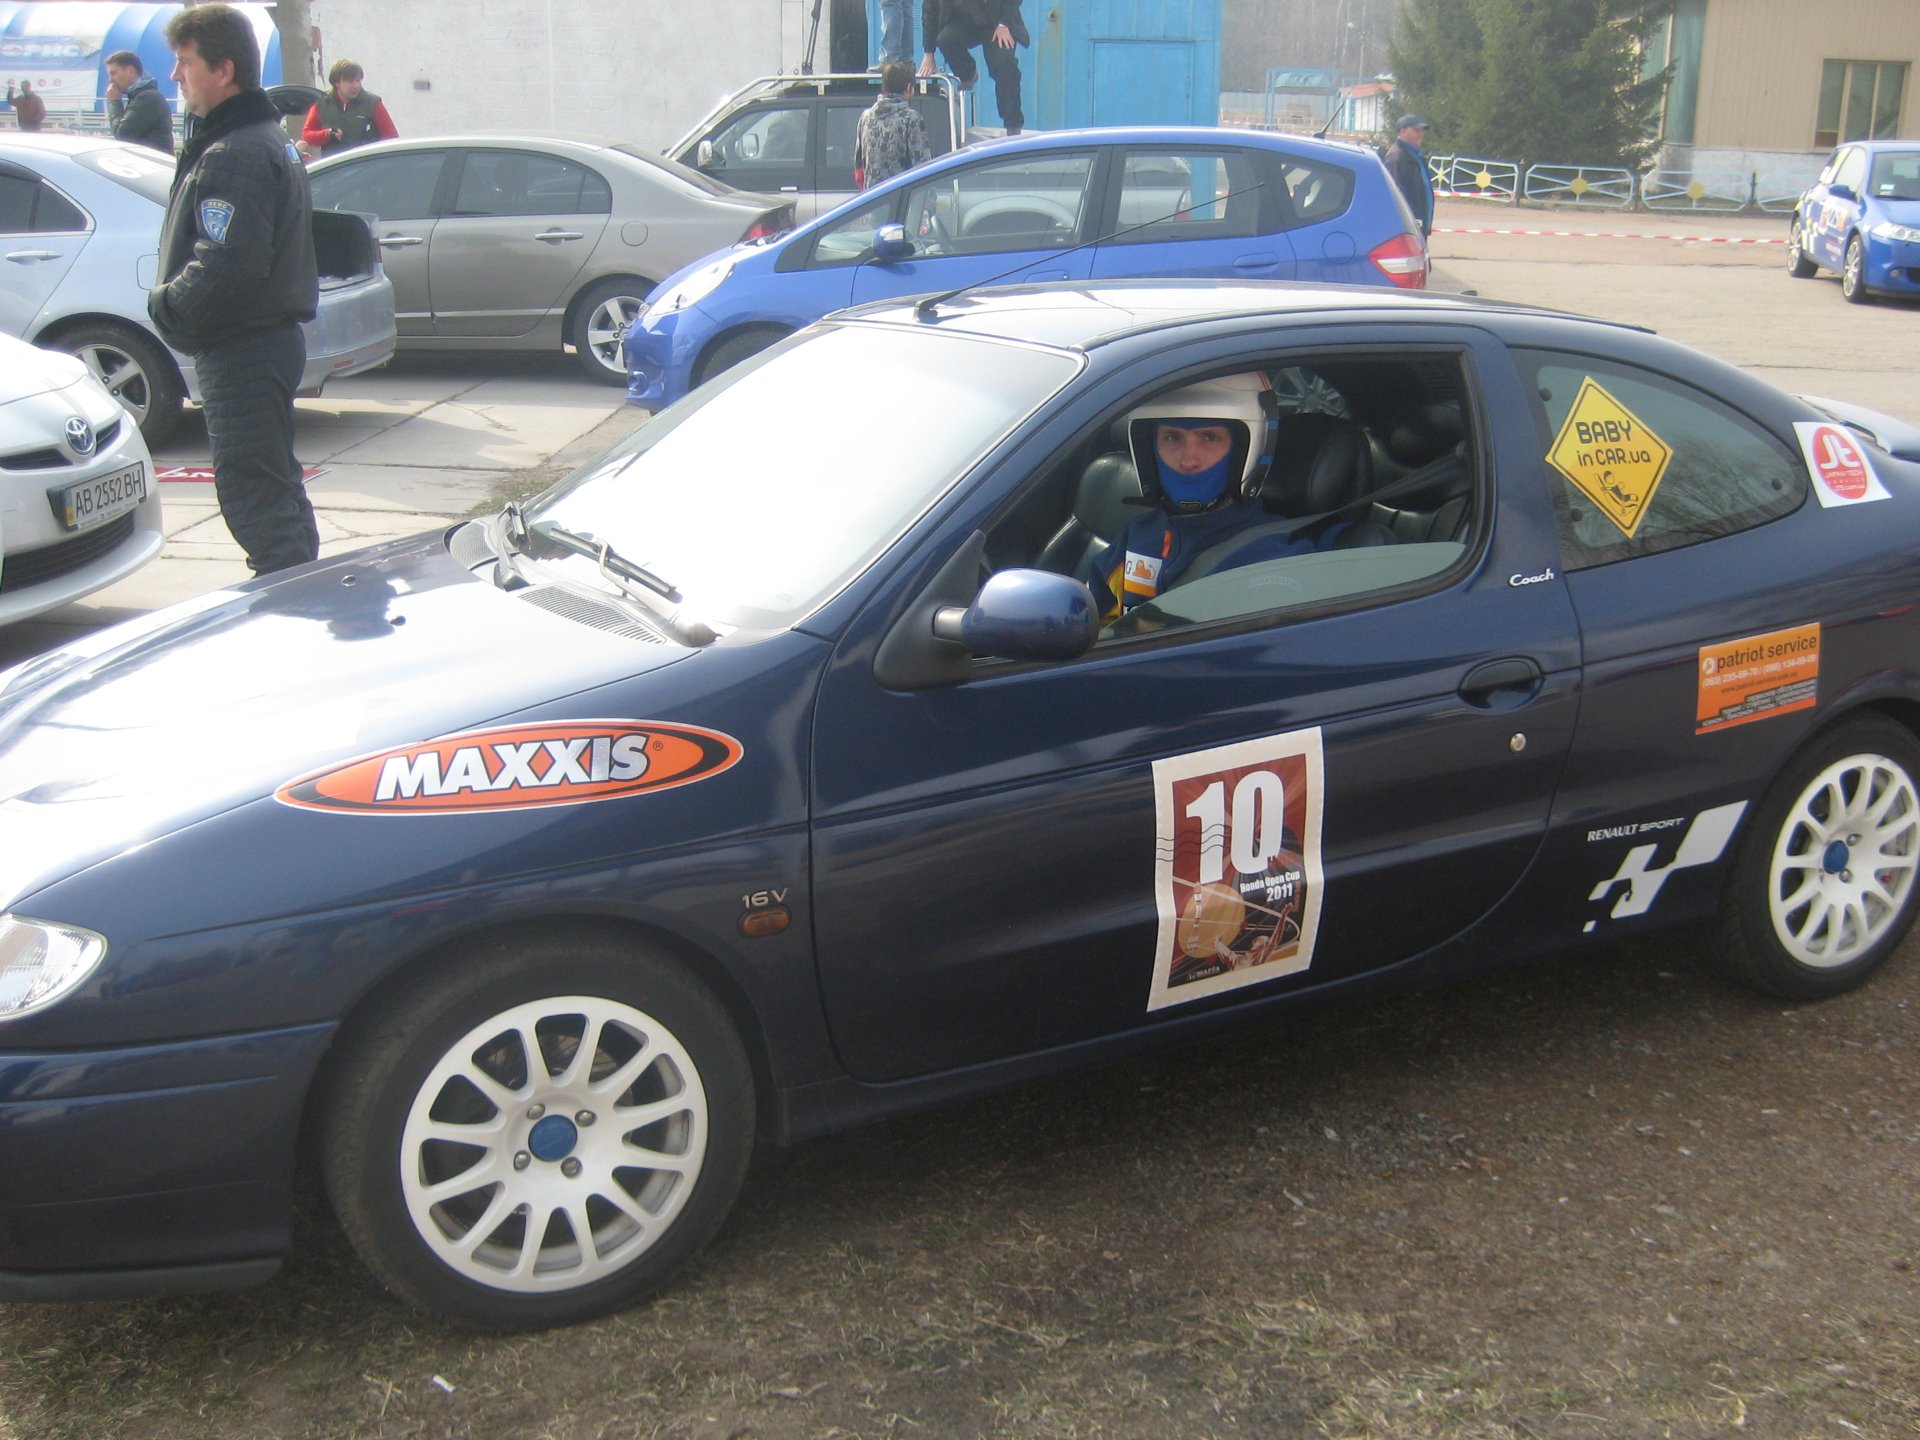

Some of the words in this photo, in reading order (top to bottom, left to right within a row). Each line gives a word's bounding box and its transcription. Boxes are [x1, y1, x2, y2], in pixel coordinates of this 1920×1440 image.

[1575, 420, 1631, 444] BABY
[1577, 450, 1593, 467] in
[1595, 447, 1651, 466] CAR.ua
[76, 488, 94, 518] AB
[95, 477, 124, 509] 2552
[124, 469, 142, 498] BH
[1509, 568, 1554, 587] Coach
[1717, 645, 1766, 673] patriot
[1767, 636, 1817, 658] service
[372, 732, 650, 801] MAXXIS
[1186, 770, 1284, 885] 10
[1587, 823, 1638, 841] RENAULT
[1639, 817, 1684, 832] SPORT
[1240, 880, 1264, 894] Honda
[1265, 875, 1284, 888] Open
[1285, 870, 1300, 882] Cup
[1266, 884, 1293, 902] 2011
[742, 887, 788, 909] 16V
